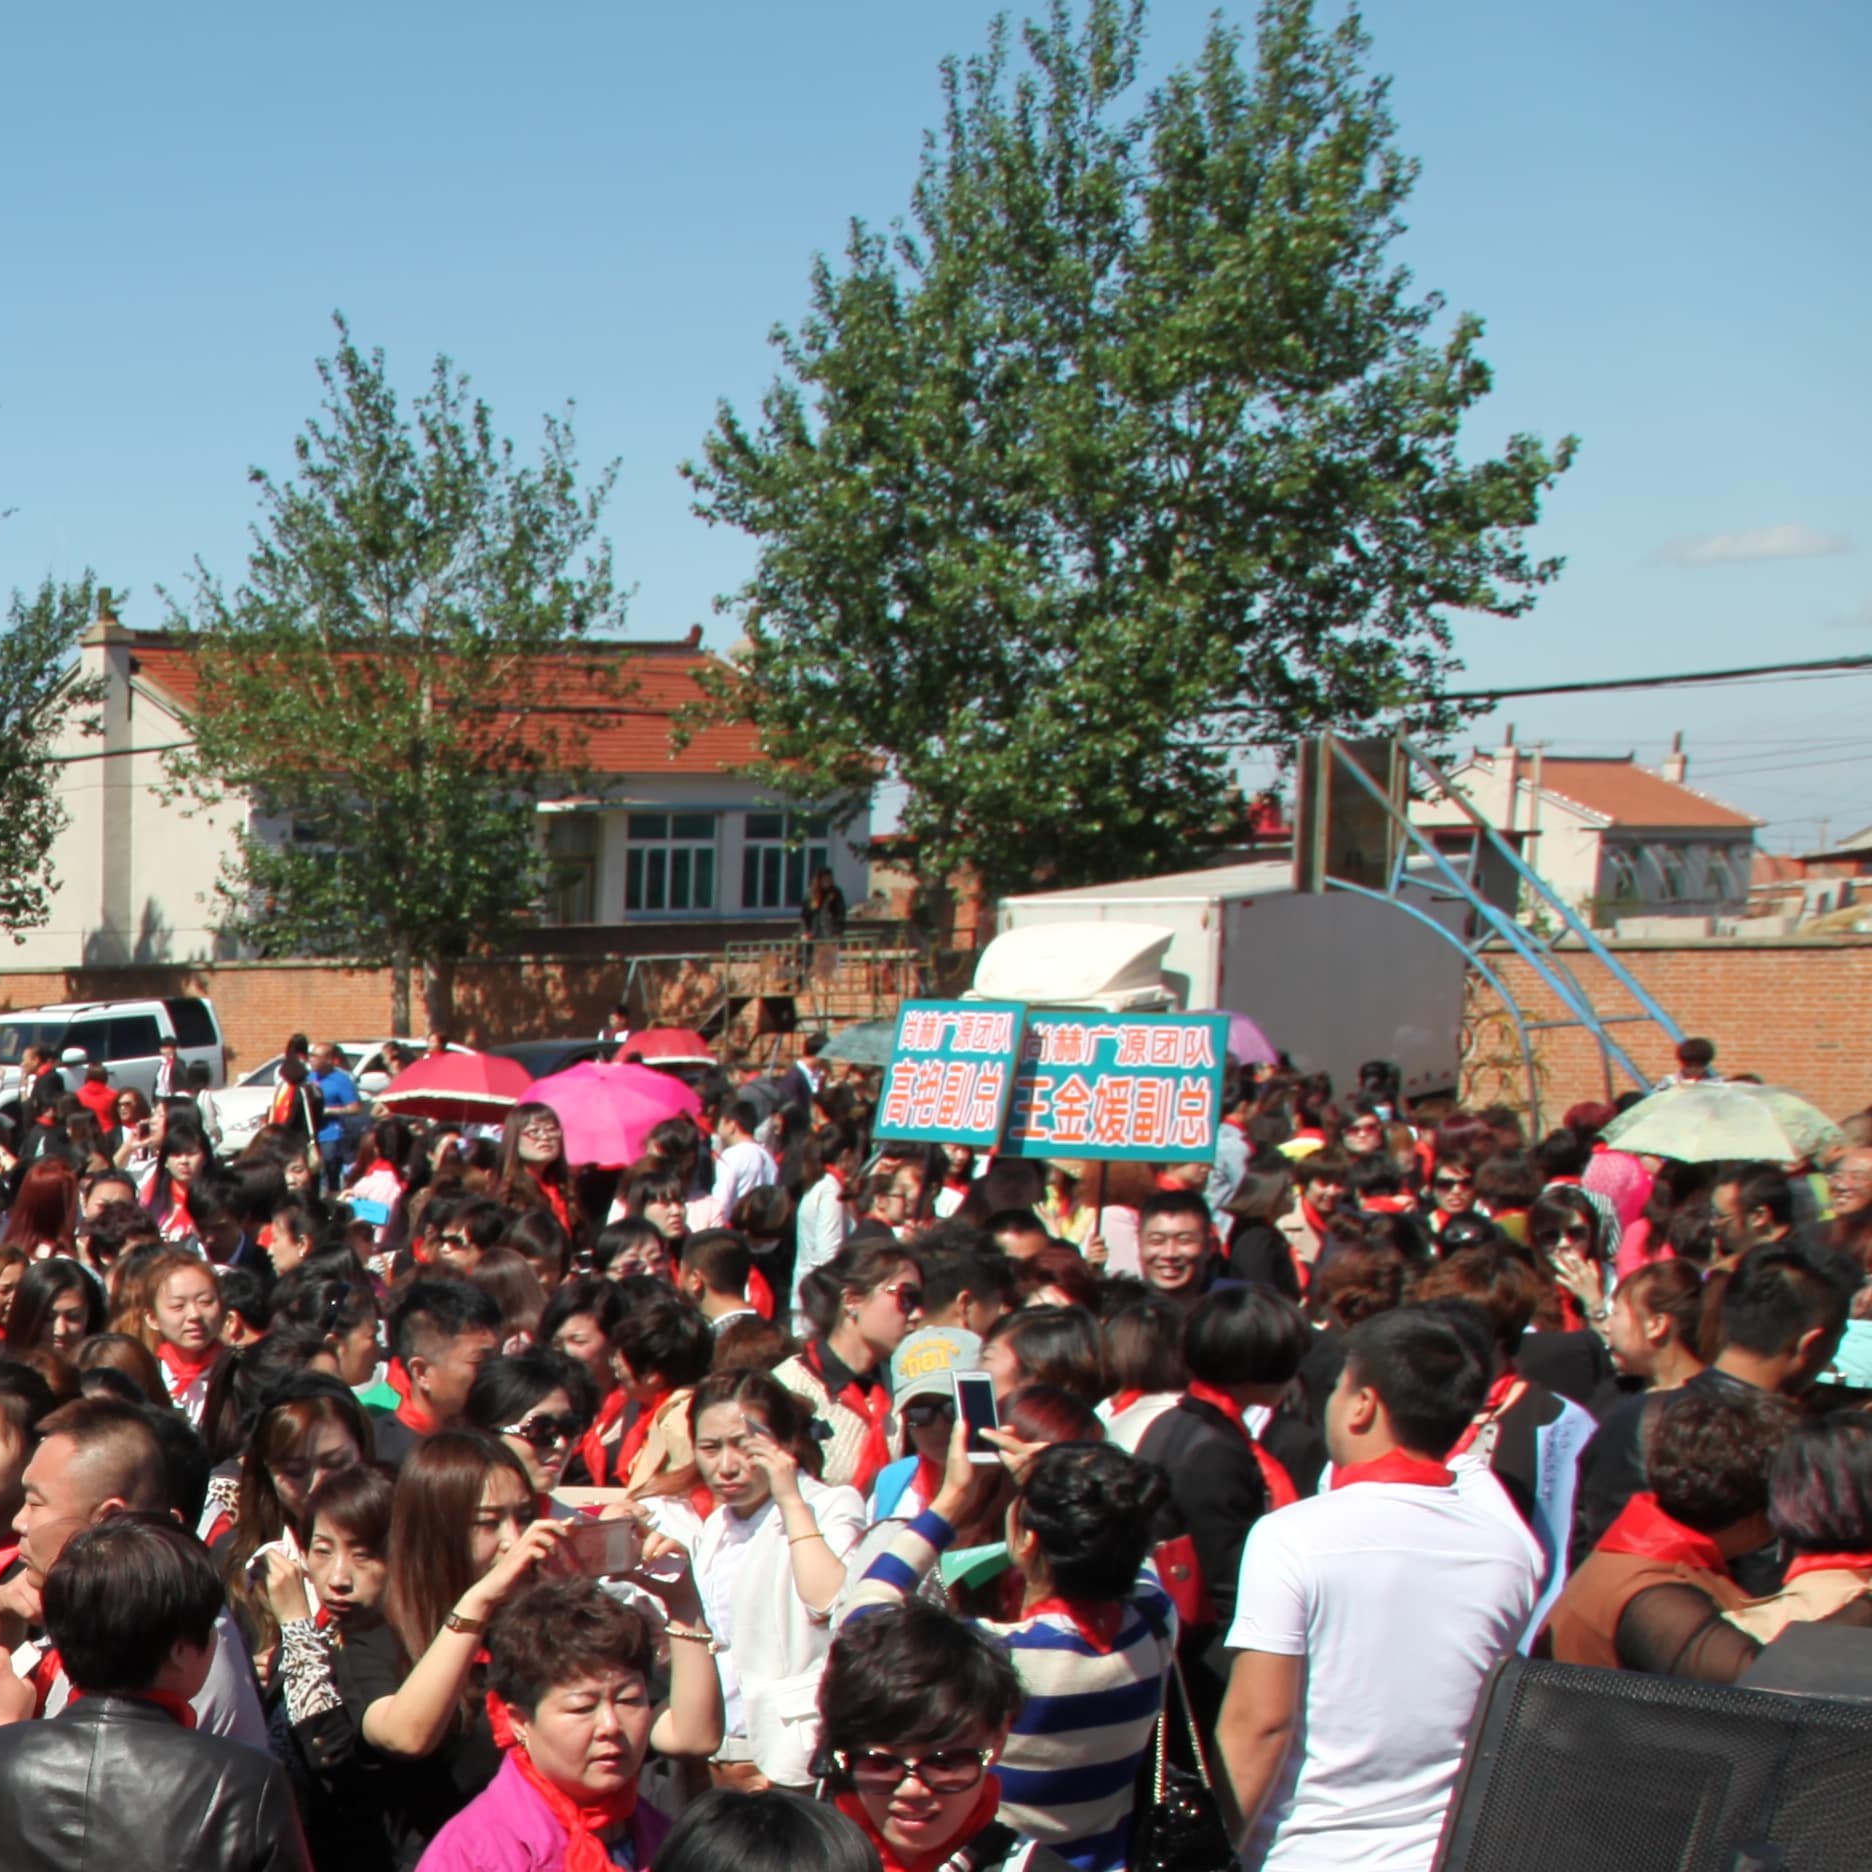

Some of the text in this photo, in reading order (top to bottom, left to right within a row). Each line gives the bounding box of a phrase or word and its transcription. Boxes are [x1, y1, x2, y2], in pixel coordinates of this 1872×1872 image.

[898, 1010, 1014, 1054] 尚赫广源团队
[1021, 1022, 1216, 1068] 尚赫广源团队
